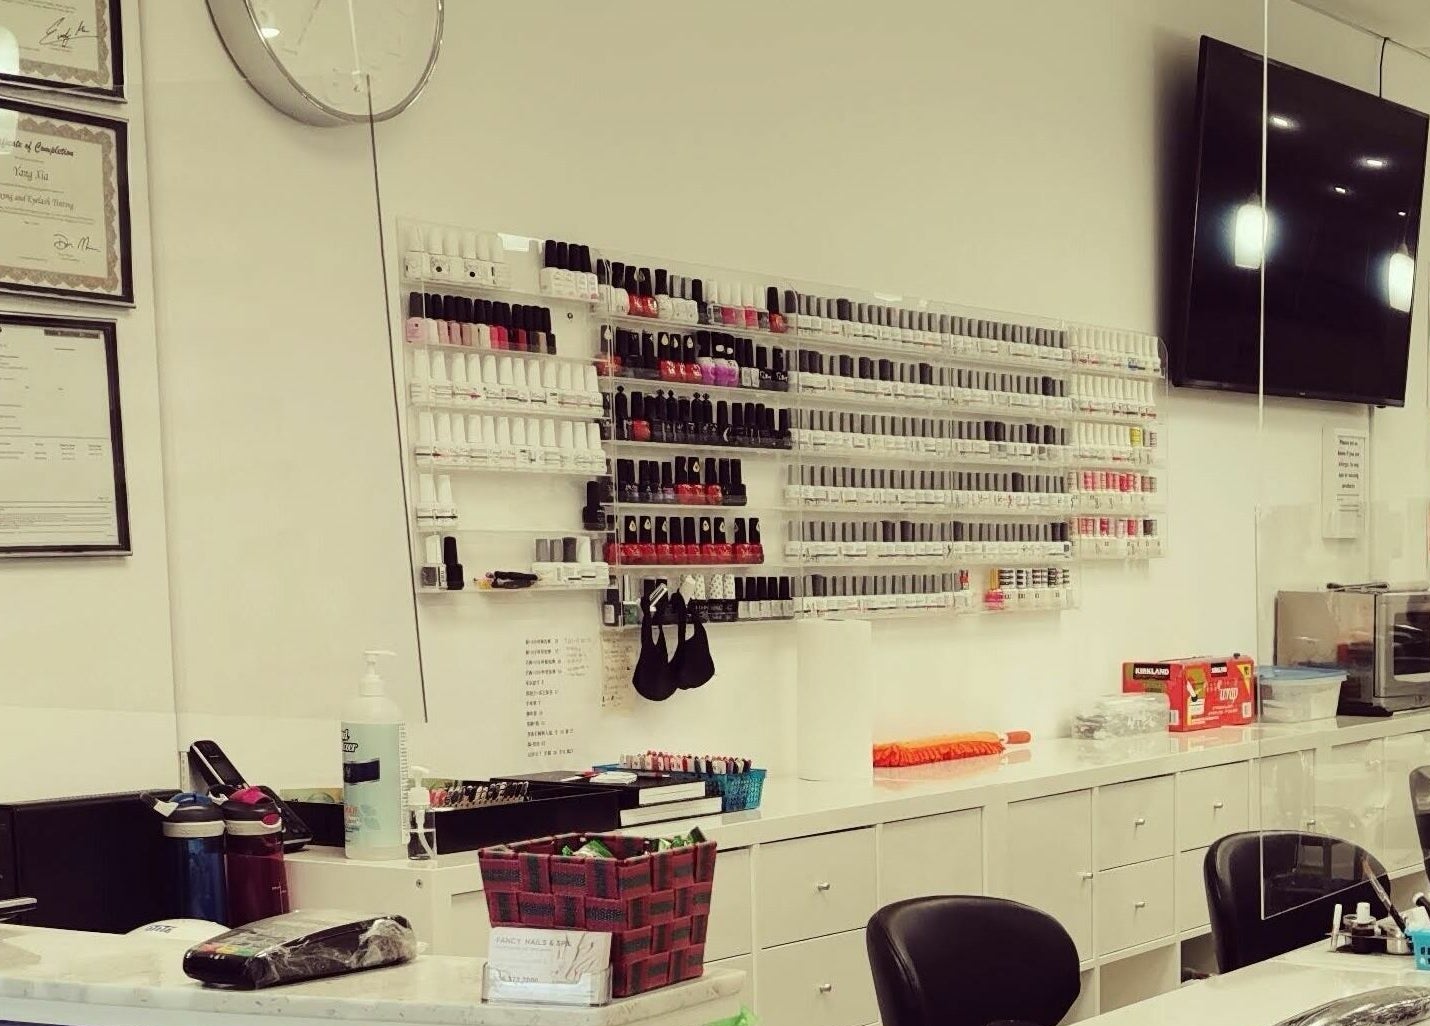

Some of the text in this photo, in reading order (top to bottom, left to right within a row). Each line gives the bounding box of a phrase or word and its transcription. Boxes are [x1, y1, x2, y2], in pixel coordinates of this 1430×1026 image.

[1135, 667, 1170, 676] KIRKLAND
[495, 936, 521, 945] FANCY
[525, 938, 547, 946] NAILS
